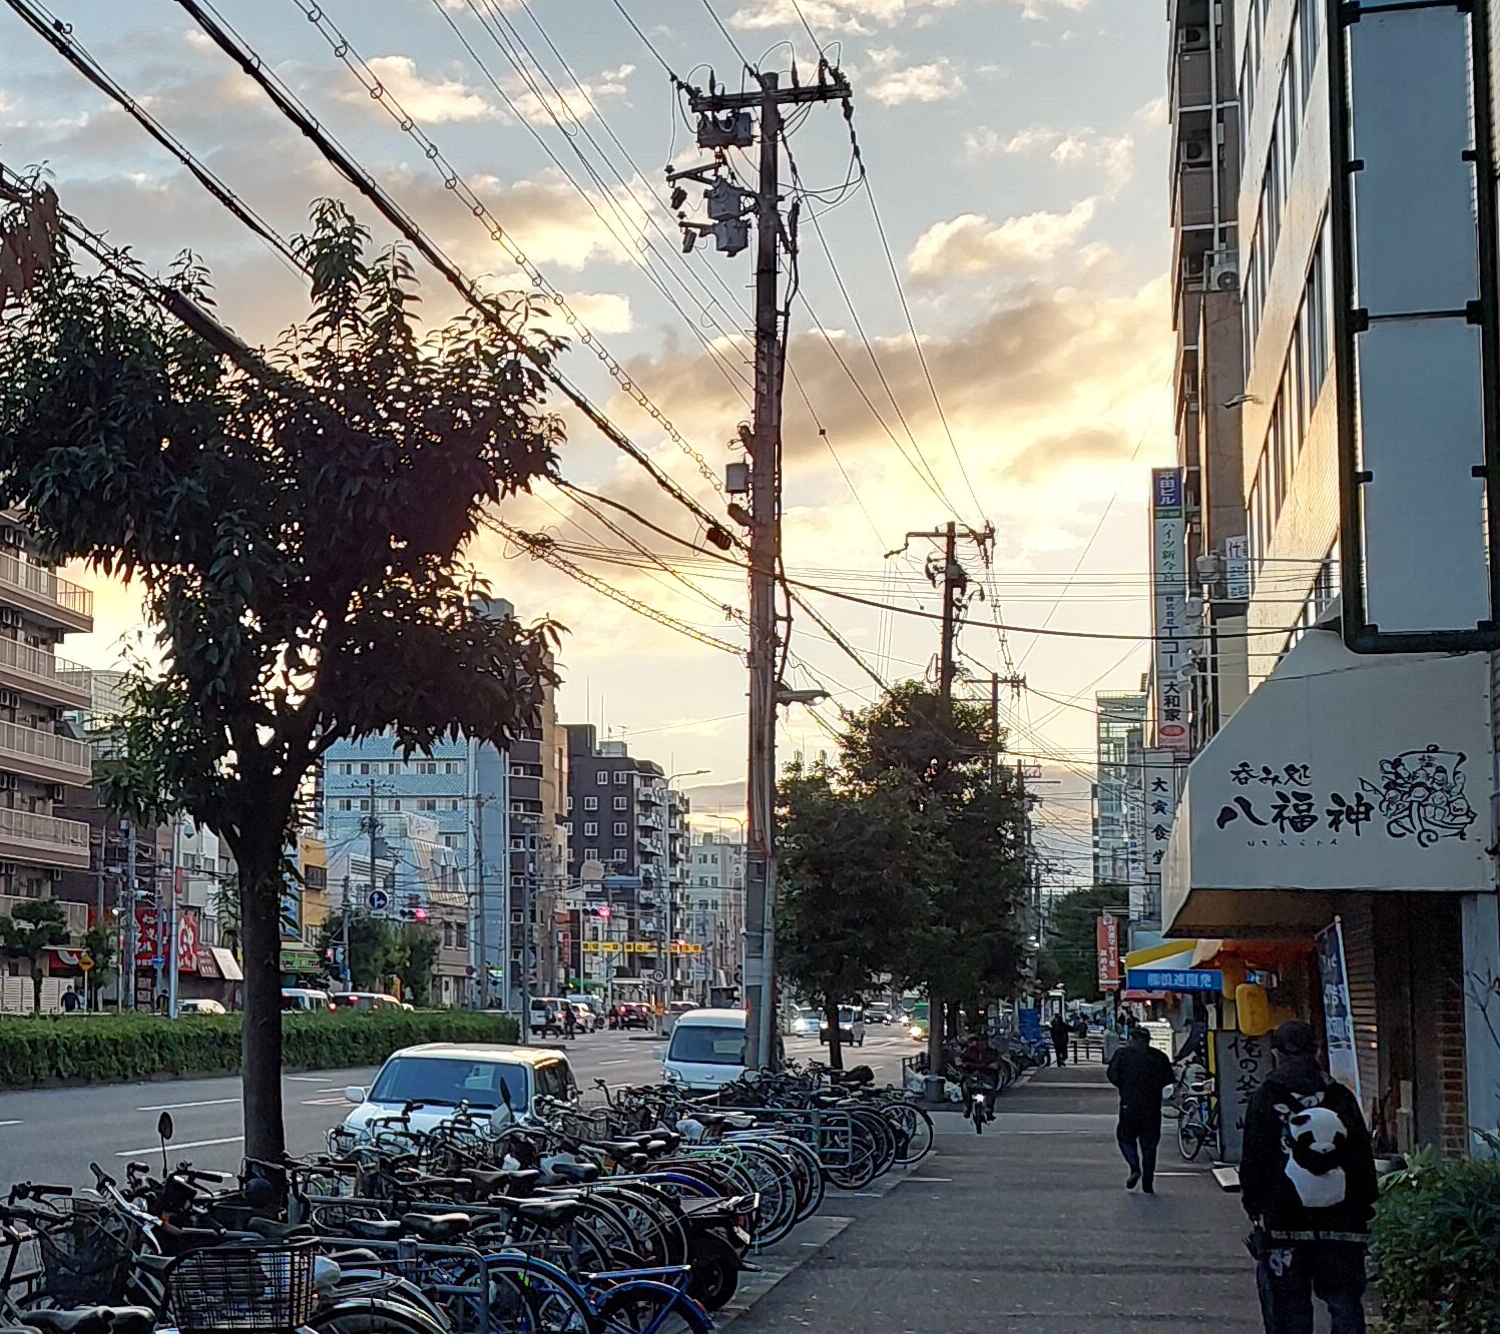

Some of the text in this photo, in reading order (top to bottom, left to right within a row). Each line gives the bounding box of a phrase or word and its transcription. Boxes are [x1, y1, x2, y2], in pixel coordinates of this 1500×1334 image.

[1160, 471, 1176, 505] 平田ビル
[1163, 681, 1181, 722] 大和家
[1229, 761, 1312, 787] 呑み処
[1216, 790, 1376, 837] 八福神
